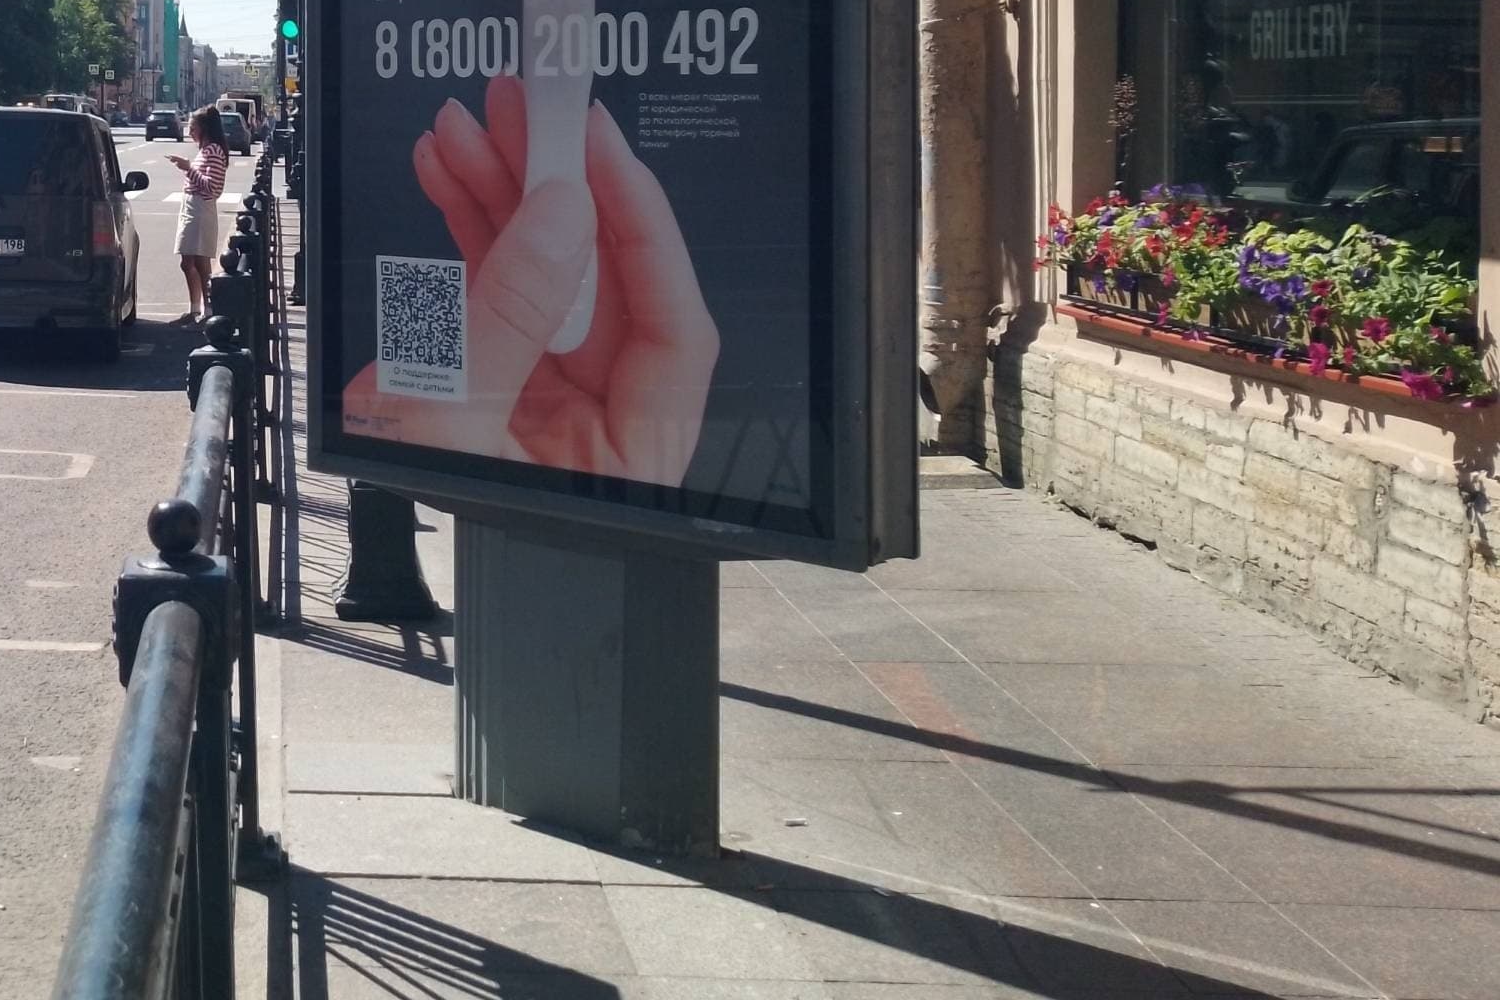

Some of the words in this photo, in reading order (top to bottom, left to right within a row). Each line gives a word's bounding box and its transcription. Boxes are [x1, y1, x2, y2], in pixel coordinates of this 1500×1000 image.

[375, 20, 398, 79] 8
[411, 16, 519, 79] (800)
[533, 11, 649, 78] 2000
[662, 7, 759, 76] 492
[1250, 0, 1353, 60] GRILLERY
[3, 239, 24, 250] 198
